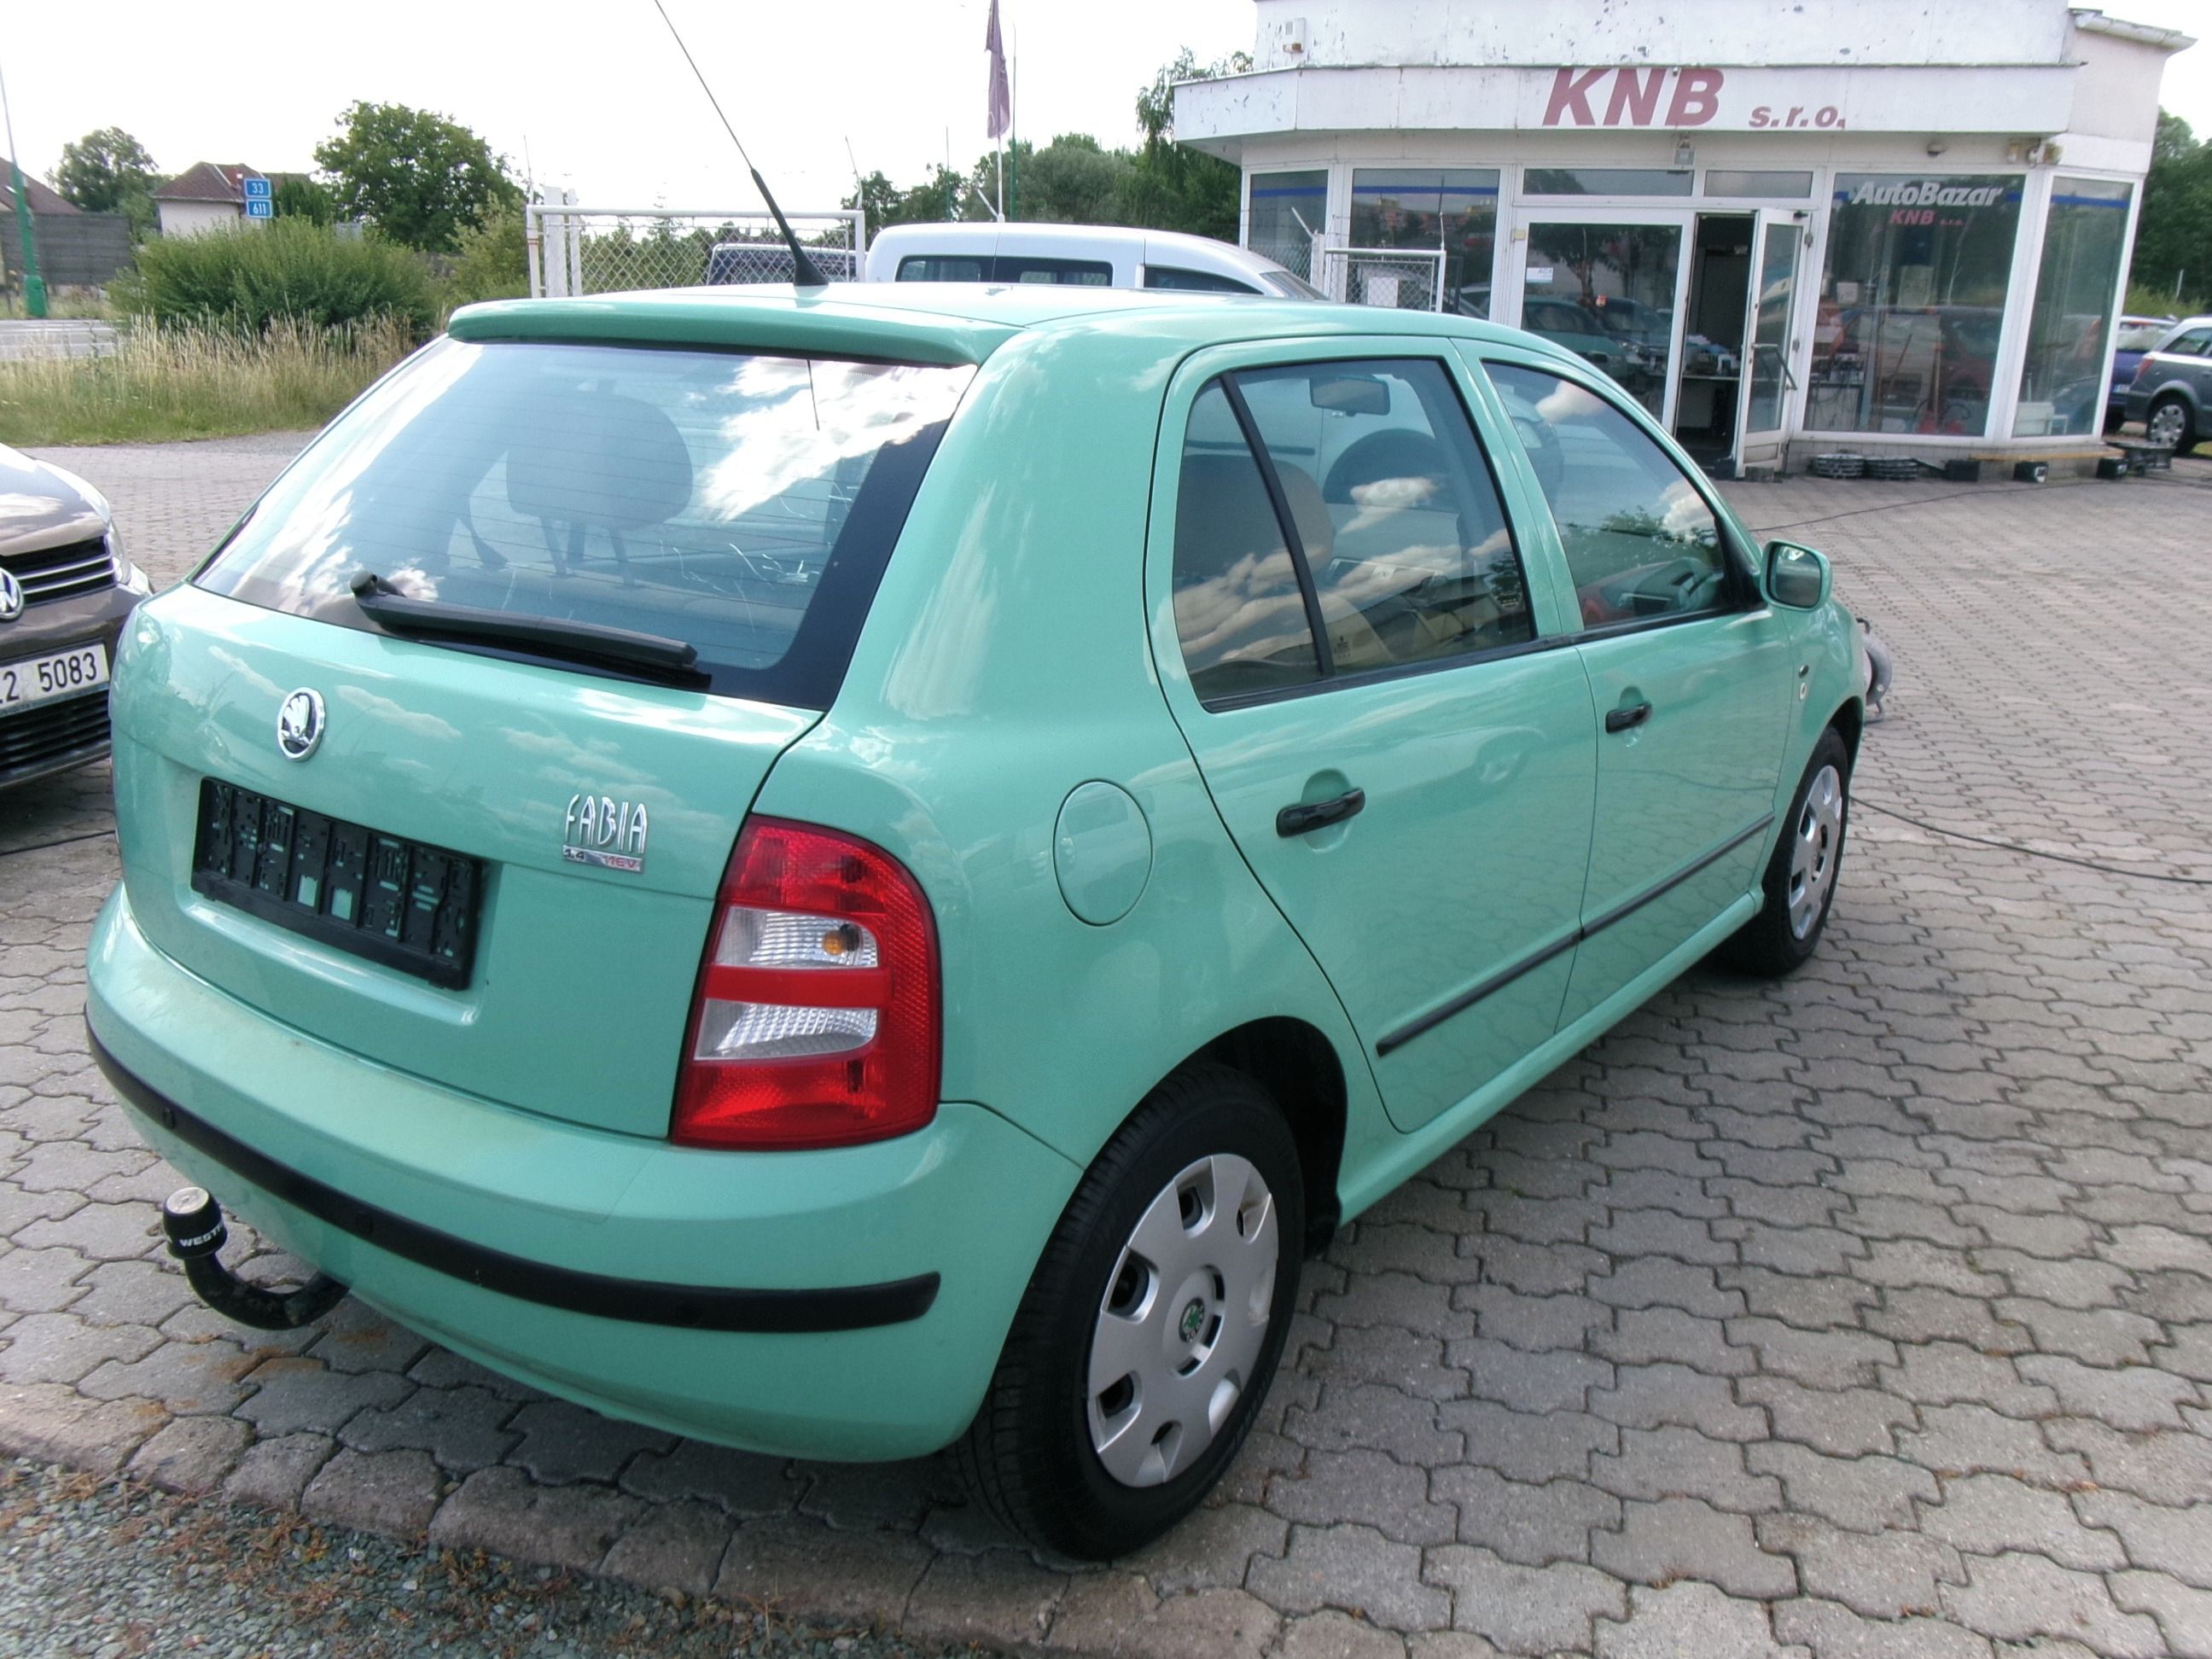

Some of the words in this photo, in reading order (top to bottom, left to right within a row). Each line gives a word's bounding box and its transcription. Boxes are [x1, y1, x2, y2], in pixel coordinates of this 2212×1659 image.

[1542, 67, 1725, 126] KNB
[1749, 106, 1847, 129] s.r.o.
[252, 183, 264, 194] 33
[1852, 182, 2004, 207] AutoBazar
[253, 202, 266, 214] 611
[1889, 210, 1936, 225] KNB
[38, 652, 97, 692] 5083
[565, 794, 647, 854] FABIA
